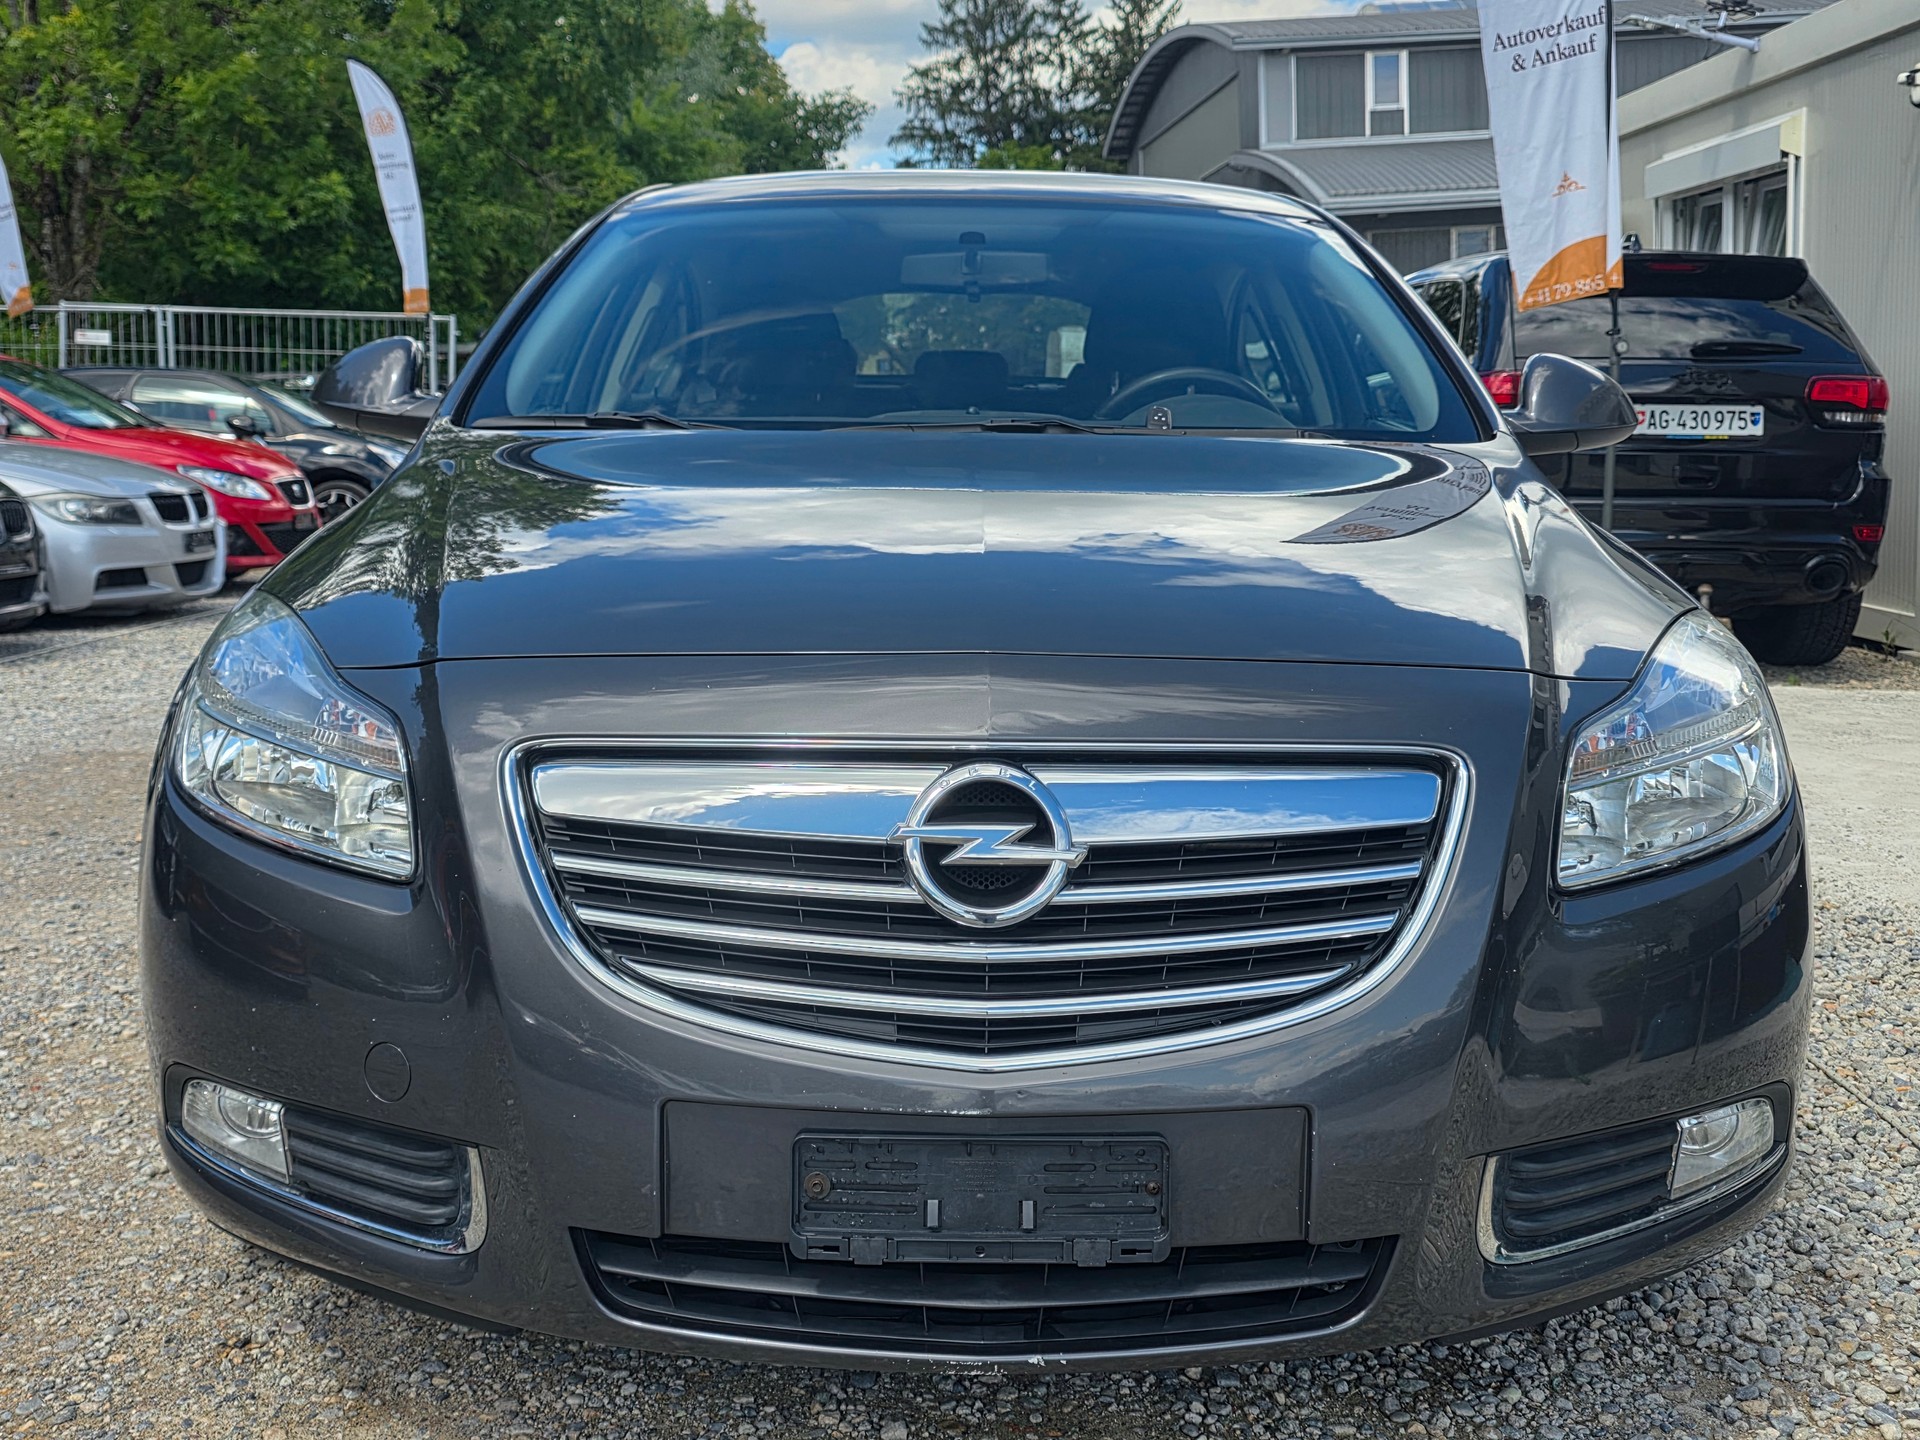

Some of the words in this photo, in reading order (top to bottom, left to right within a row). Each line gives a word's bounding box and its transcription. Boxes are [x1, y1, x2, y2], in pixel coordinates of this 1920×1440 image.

[1492, 5, 1607, 52] Autoverkauf
[1511, 52, 1526, 73] &
[1532, 33, 1598, 66] Ankauf
